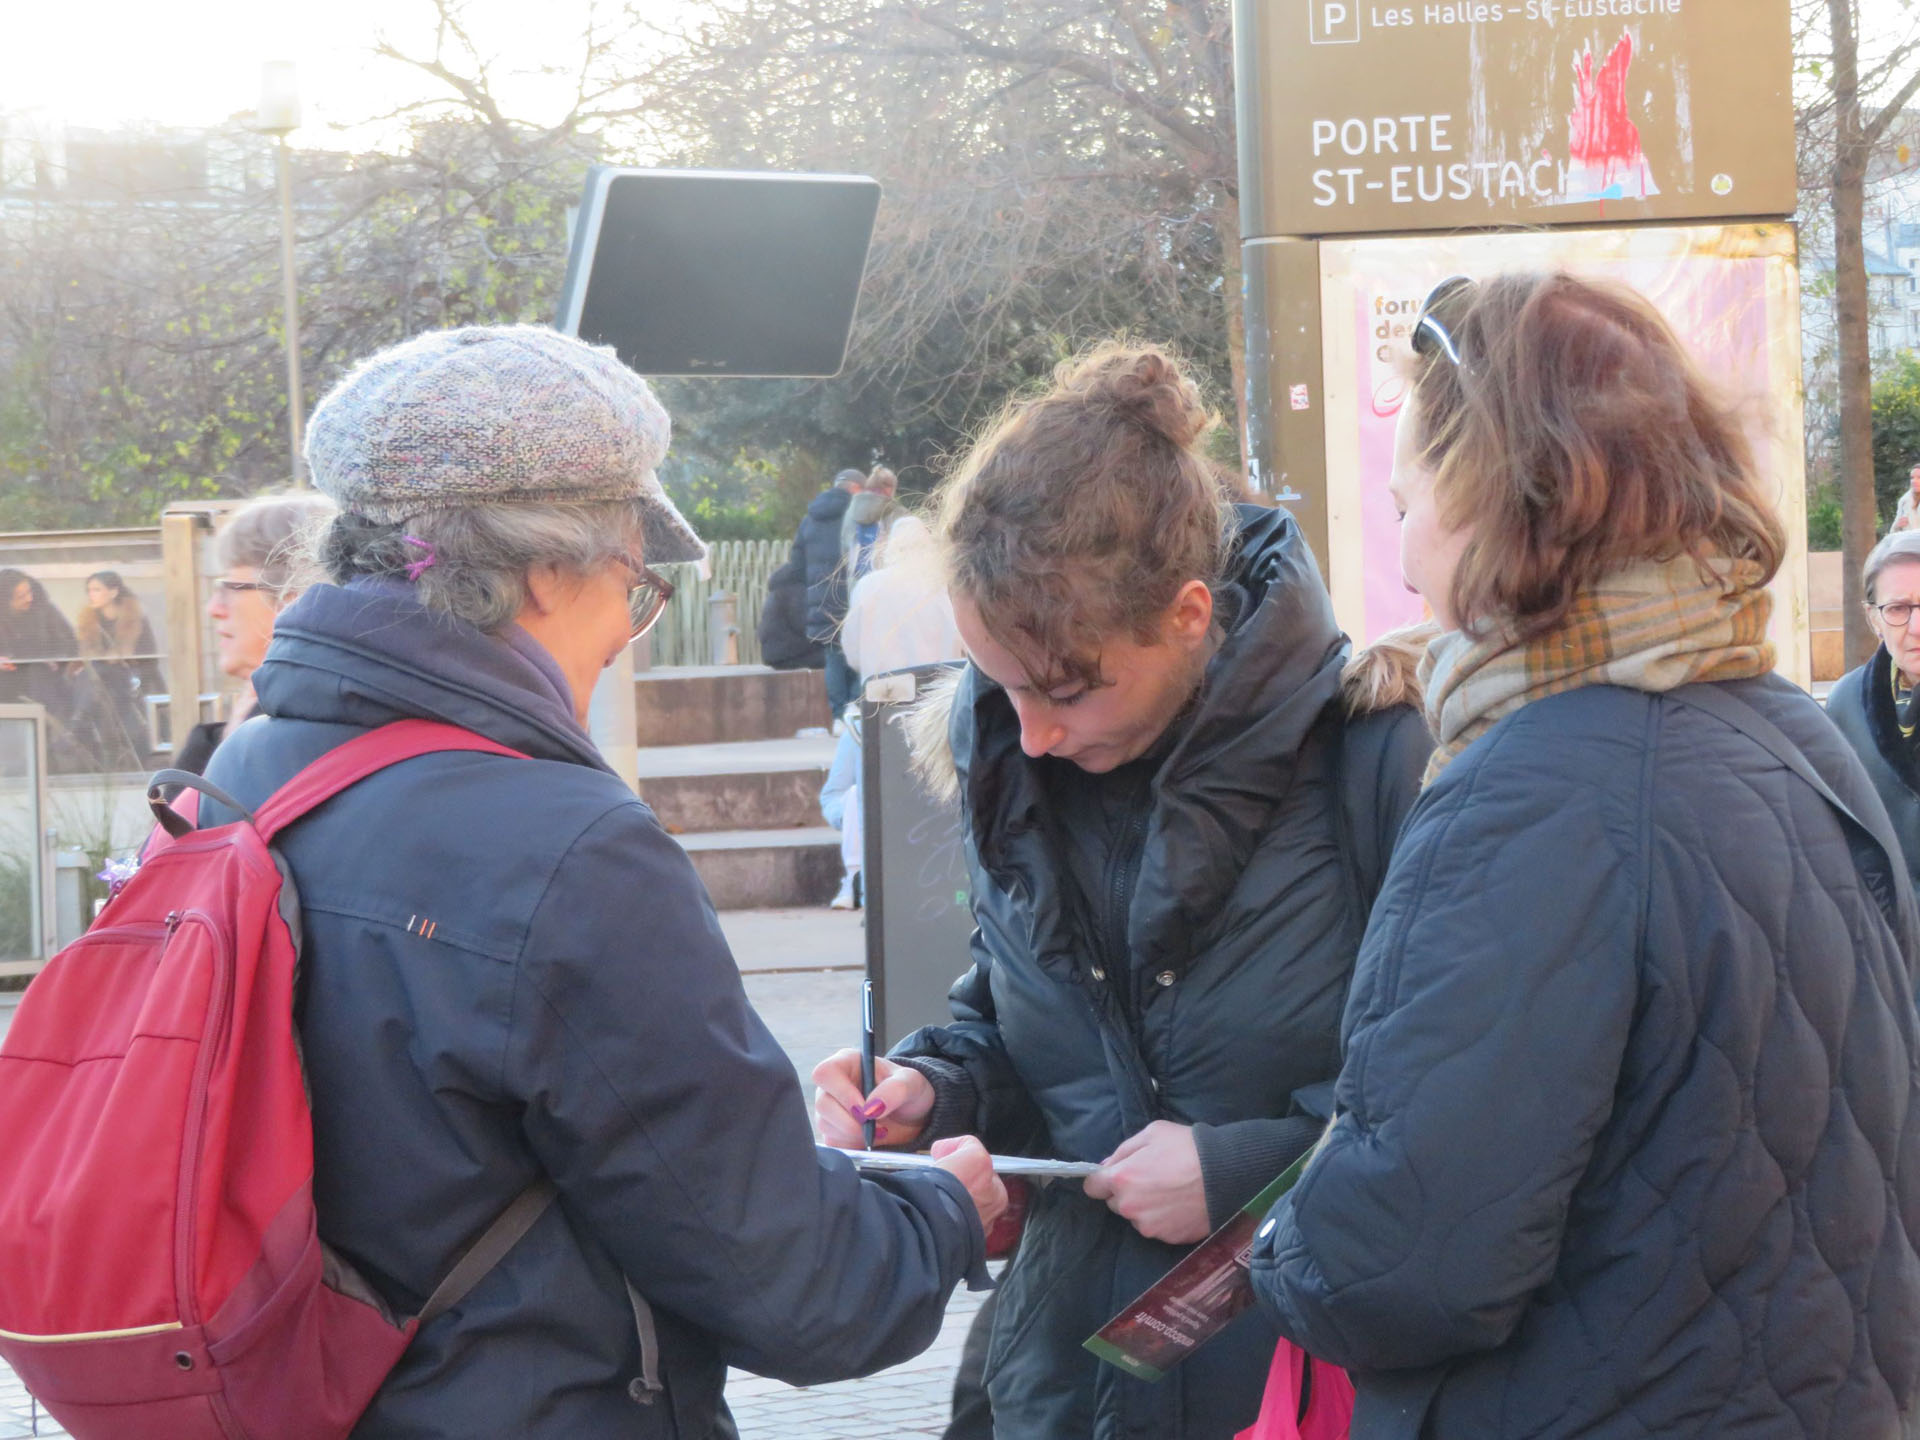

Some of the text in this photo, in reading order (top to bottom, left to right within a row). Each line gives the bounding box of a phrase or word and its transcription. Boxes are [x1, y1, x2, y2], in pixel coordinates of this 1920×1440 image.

[1324, 3, 1347, 35] P
[1371, 7, 1414, 27] Les
[1312, 114, 1453, 156] PORTE
